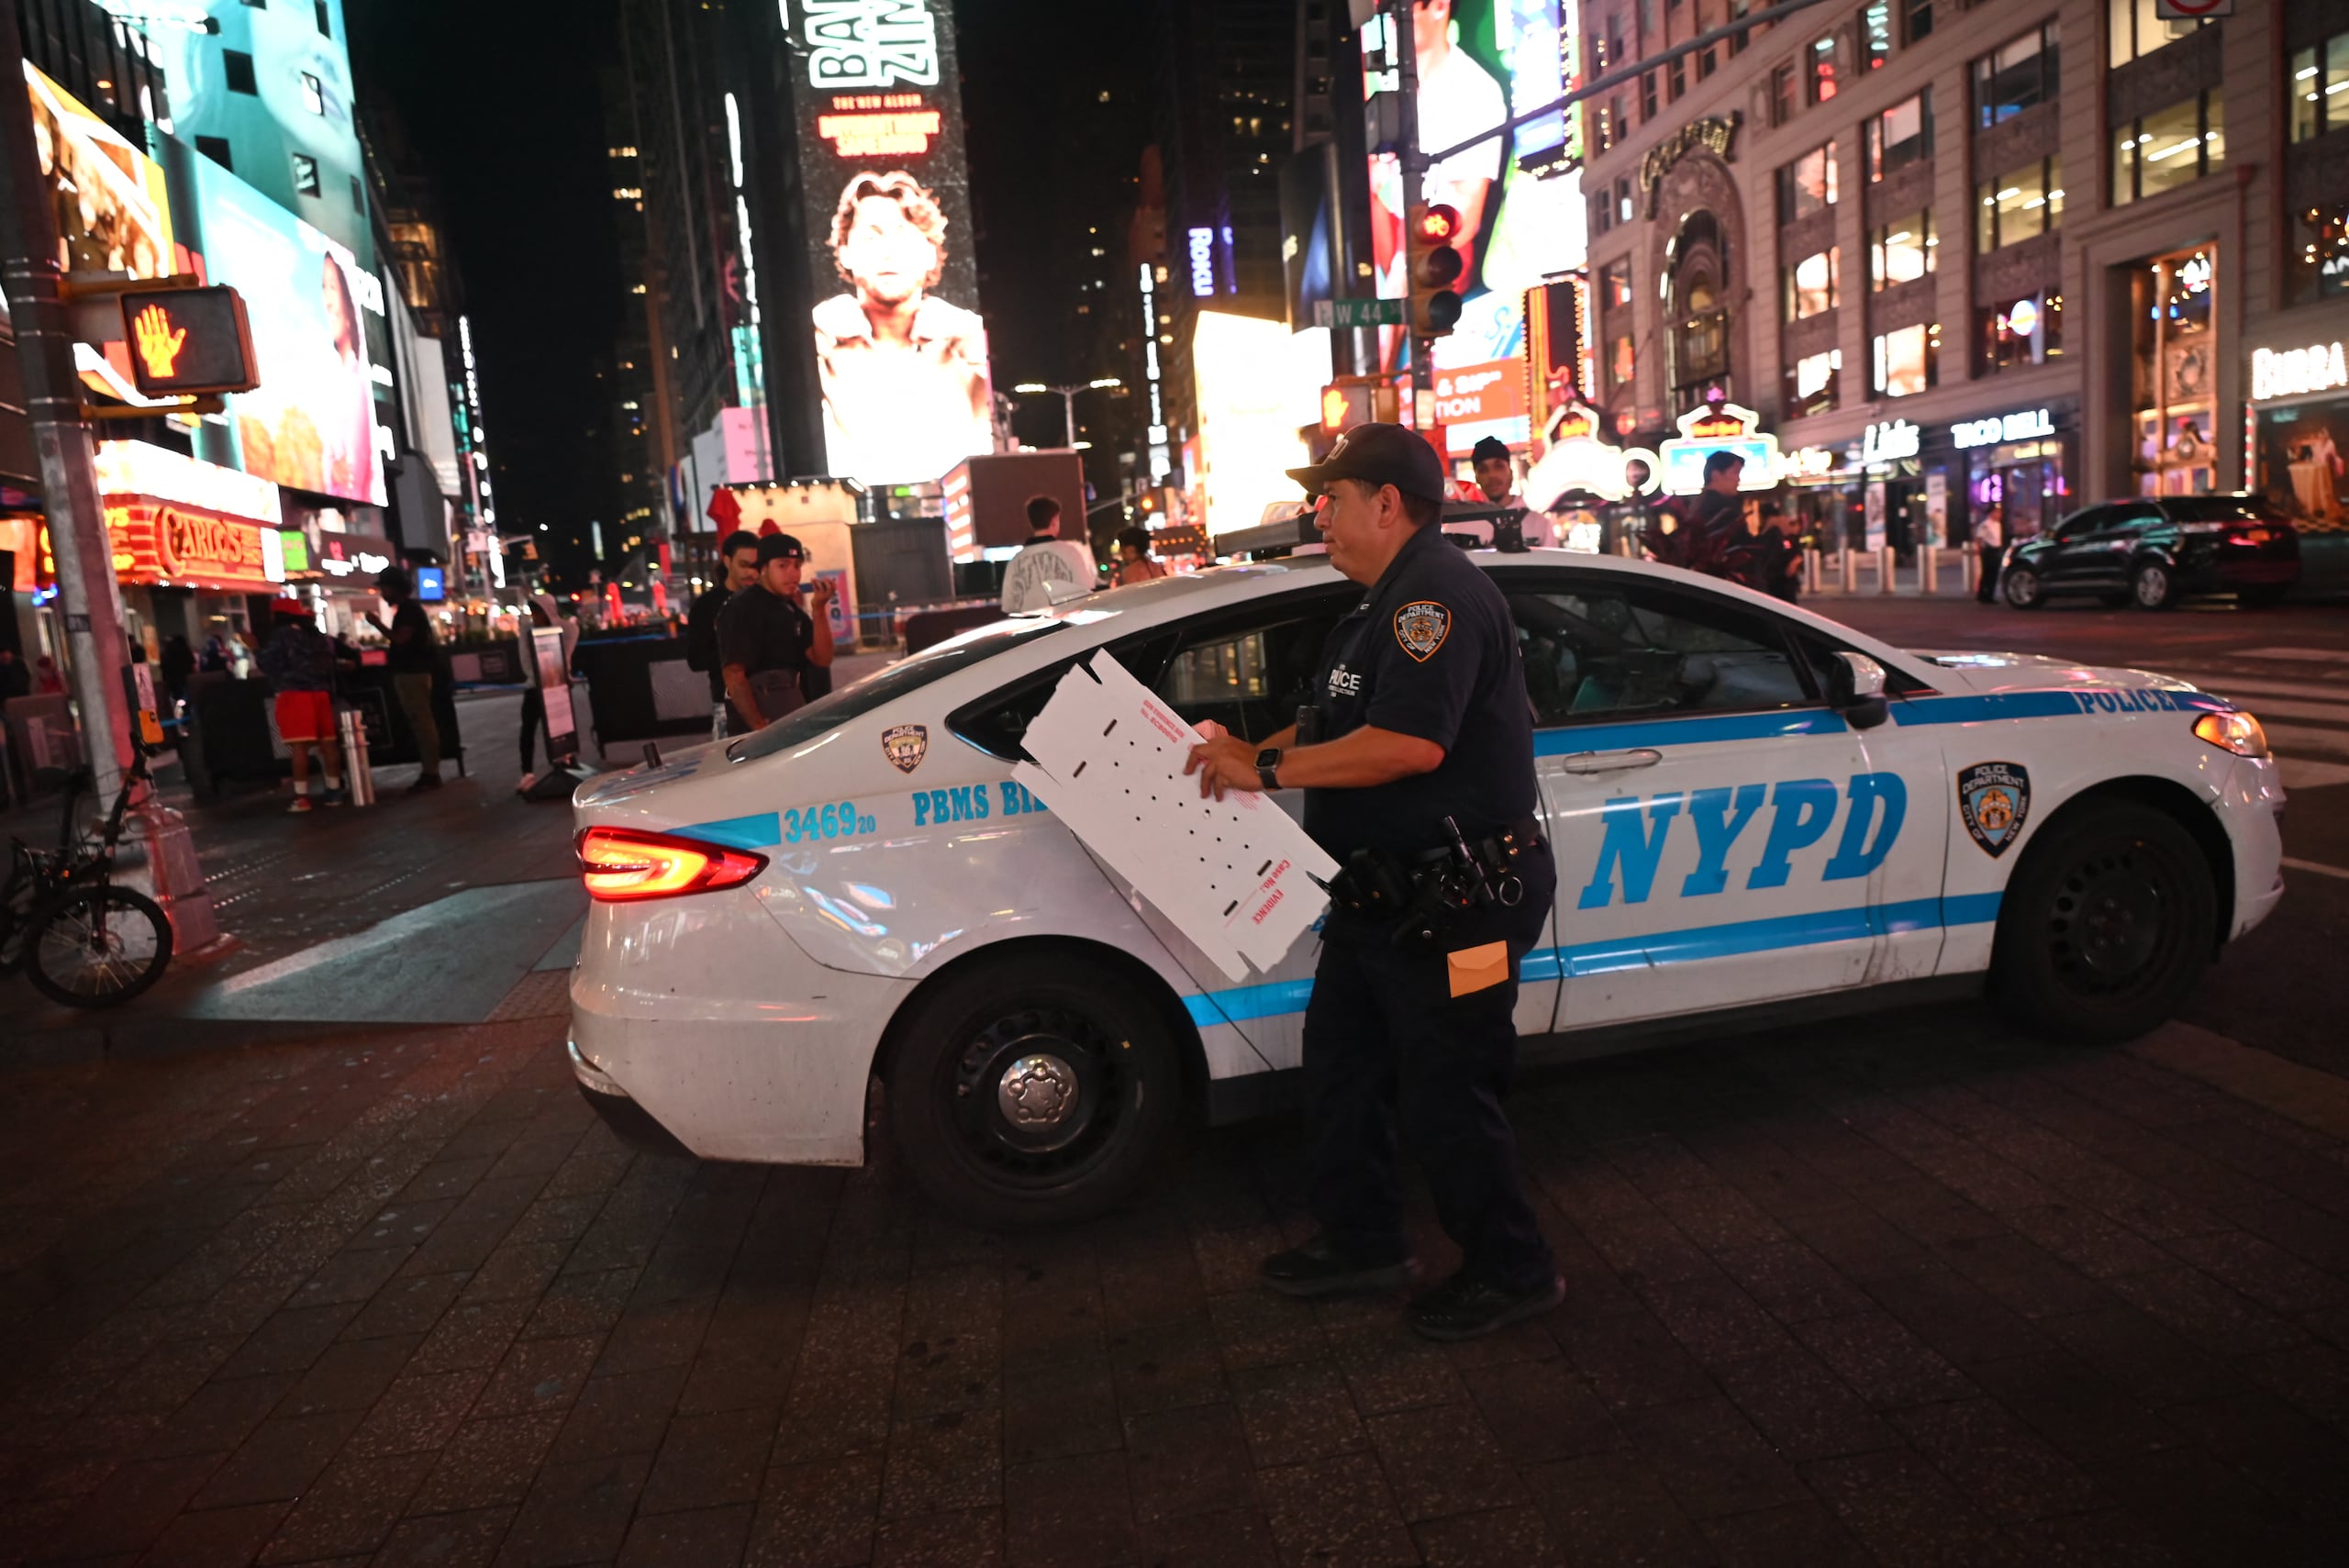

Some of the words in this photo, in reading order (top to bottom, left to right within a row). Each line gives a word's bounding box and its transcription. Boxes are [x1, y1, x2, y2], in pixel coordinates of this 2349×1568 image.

[1336, 304, 1352, 324] W
[1361, 303, 1382, 324] 44
[1951, 417, 2002, 449] TACO
[2002, 409, 2055, 441] BELL
[1398, 610, 1445, 624] DEPARTMENT
[1408, 605, 1434, 613] POLICE
[2073, 688, 2177, 714] POLICE
[1975, 764, 2009, 777] POLICE
[1963, 774, 2024, 794] DEPARTMENT
[912, 784, 989, 827] PBMS
[785, 801, 856, 843] 3469
[858, 815, 876, 834] 20
[1577, 772, 1908, 910] NYPD
[1252, 888, 1285, 925] EVIDENCE
